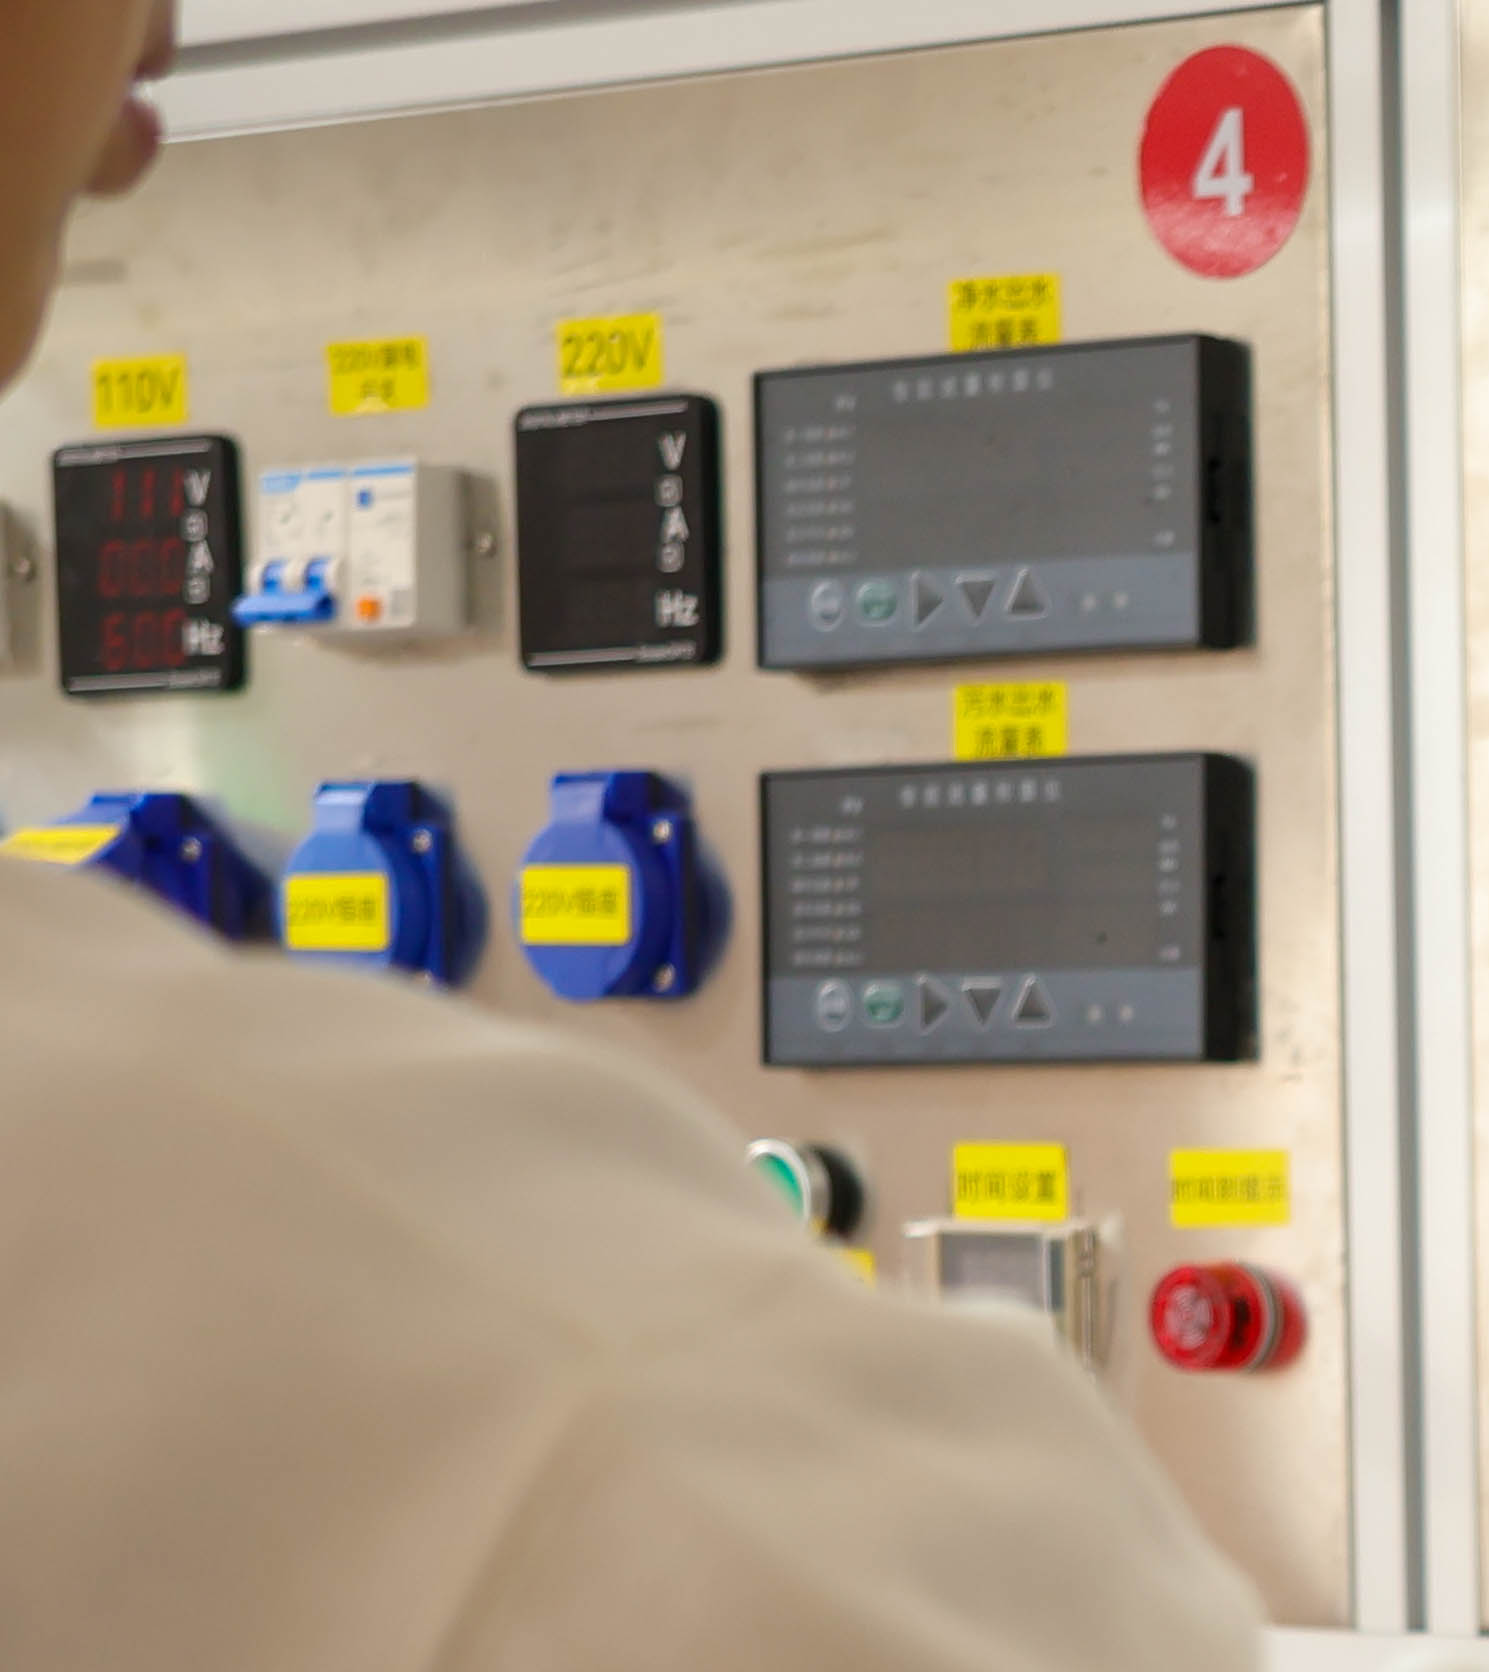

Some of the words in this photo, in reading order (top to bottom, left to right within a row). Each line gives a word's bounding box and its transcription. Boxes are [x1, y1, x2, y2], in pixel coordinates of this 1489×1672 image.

[1192, 108, 1253, 216] 4
[562, 326, 655, 378] 220V
[95, 367, 181, 413] 110V
[658, 432, 686, 470] V
[656, 592, 700, 628] Hz
[183, 622, 224, 656] Hz
